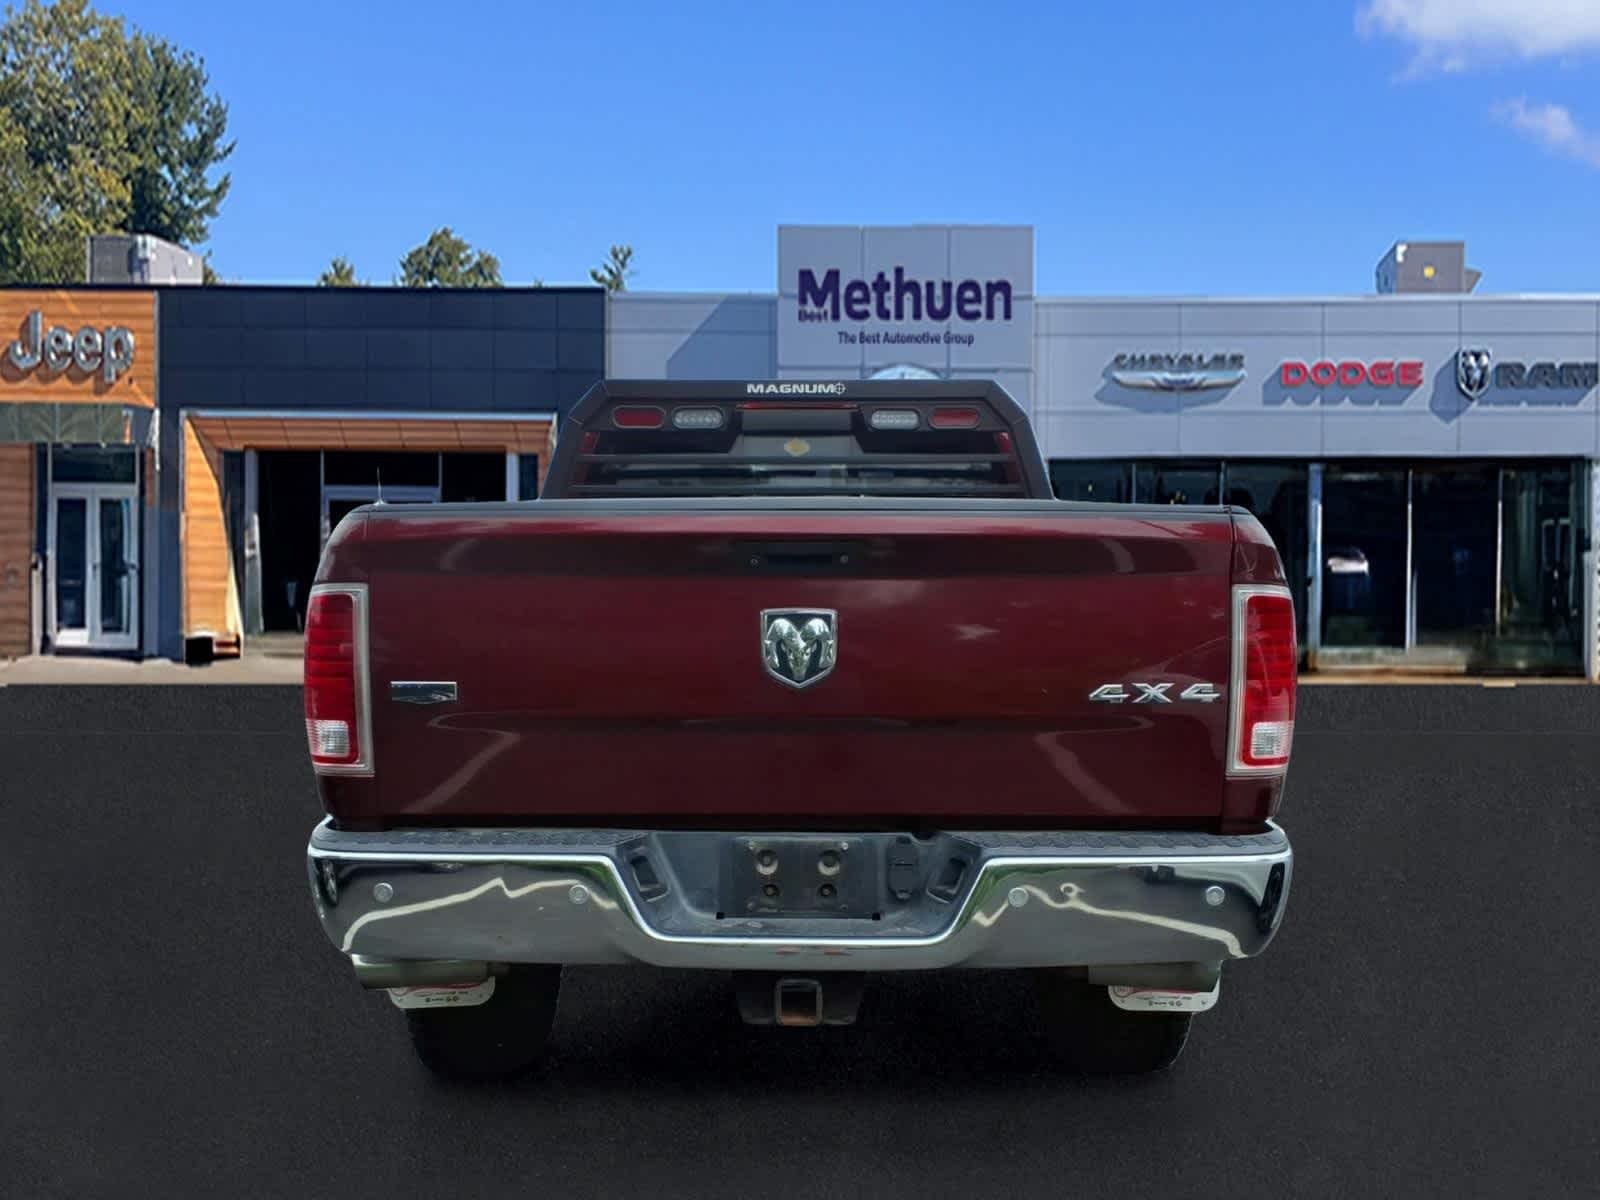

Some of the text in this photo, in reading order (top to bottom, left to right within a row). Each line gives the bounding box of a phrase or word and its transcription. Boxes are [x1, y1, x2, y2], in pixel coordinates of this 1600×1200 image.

[798, 266, 1013, 321] Methuen
[798, 309, 829, 322] Best
[9, 309, 135, 384] Jeep
[838, 331, 974, 347] The Best Automotive Group
[1114, 353, 1245, 371] CHRYSLER
[1281, 360, 1424, 387] DODGE
[1495, 362, 1599, 389] RAM
[746, 383, 834, 394] MAGNUM
[1088, 682, 1221, 704] 4X4
